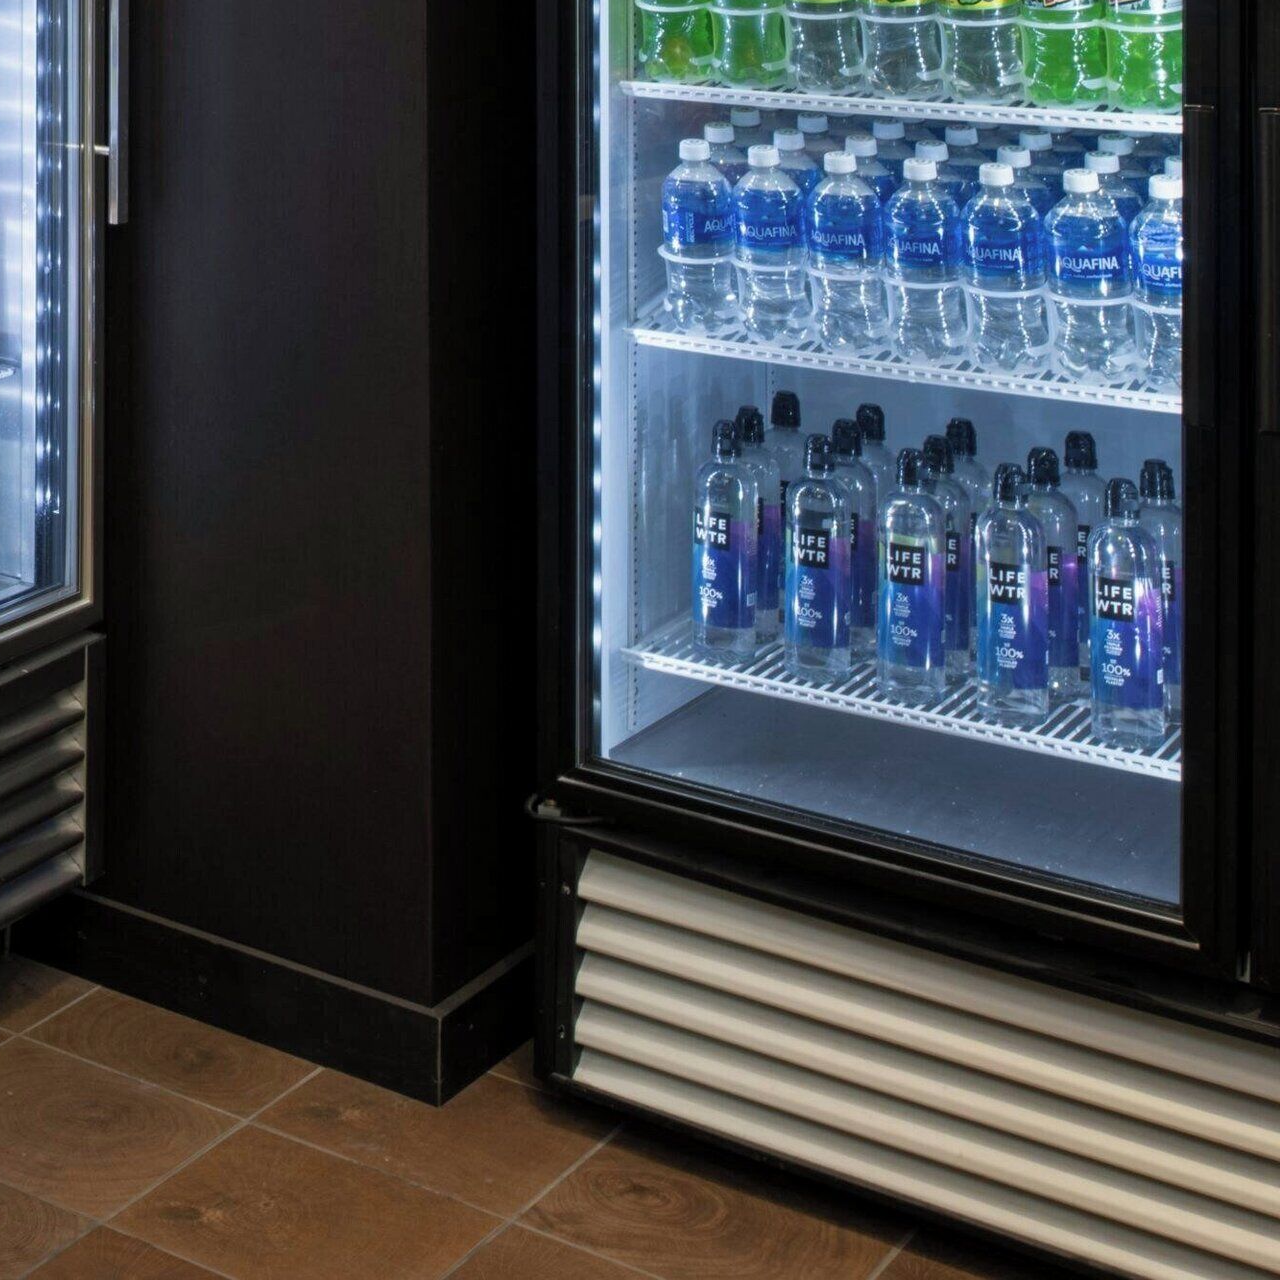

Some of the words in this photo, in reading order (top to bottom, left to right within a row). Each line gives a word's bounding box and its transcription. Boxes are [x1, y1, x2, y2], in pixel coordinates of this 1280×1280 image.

[811, 230, 865, 246] AQUAFINA
[1060, 256, 1119, 271] AQUAFINA
[697, 512, 726, 530] LIFE
[696, 528, 726, 545] WTR
[794, 534, 826, 548] LIFE
[794, 549, 826, 562] WTR
[887, 551, 921, 564] LIFE
[886, 565, 921, 579] WTR
[990, 570, 1025, 584] LIFE
[990, 585, 1025, 600] WTR
[1096, 585, 1132, 600] LIFE
[797, 607, 822, 619] 100%
[1096, 601, 1132, 616] WTR
[891, 625, 917, 638] 100%
[995, 646, 1024, 659] 100%
[1101, 662, 1130, 675] 100%
